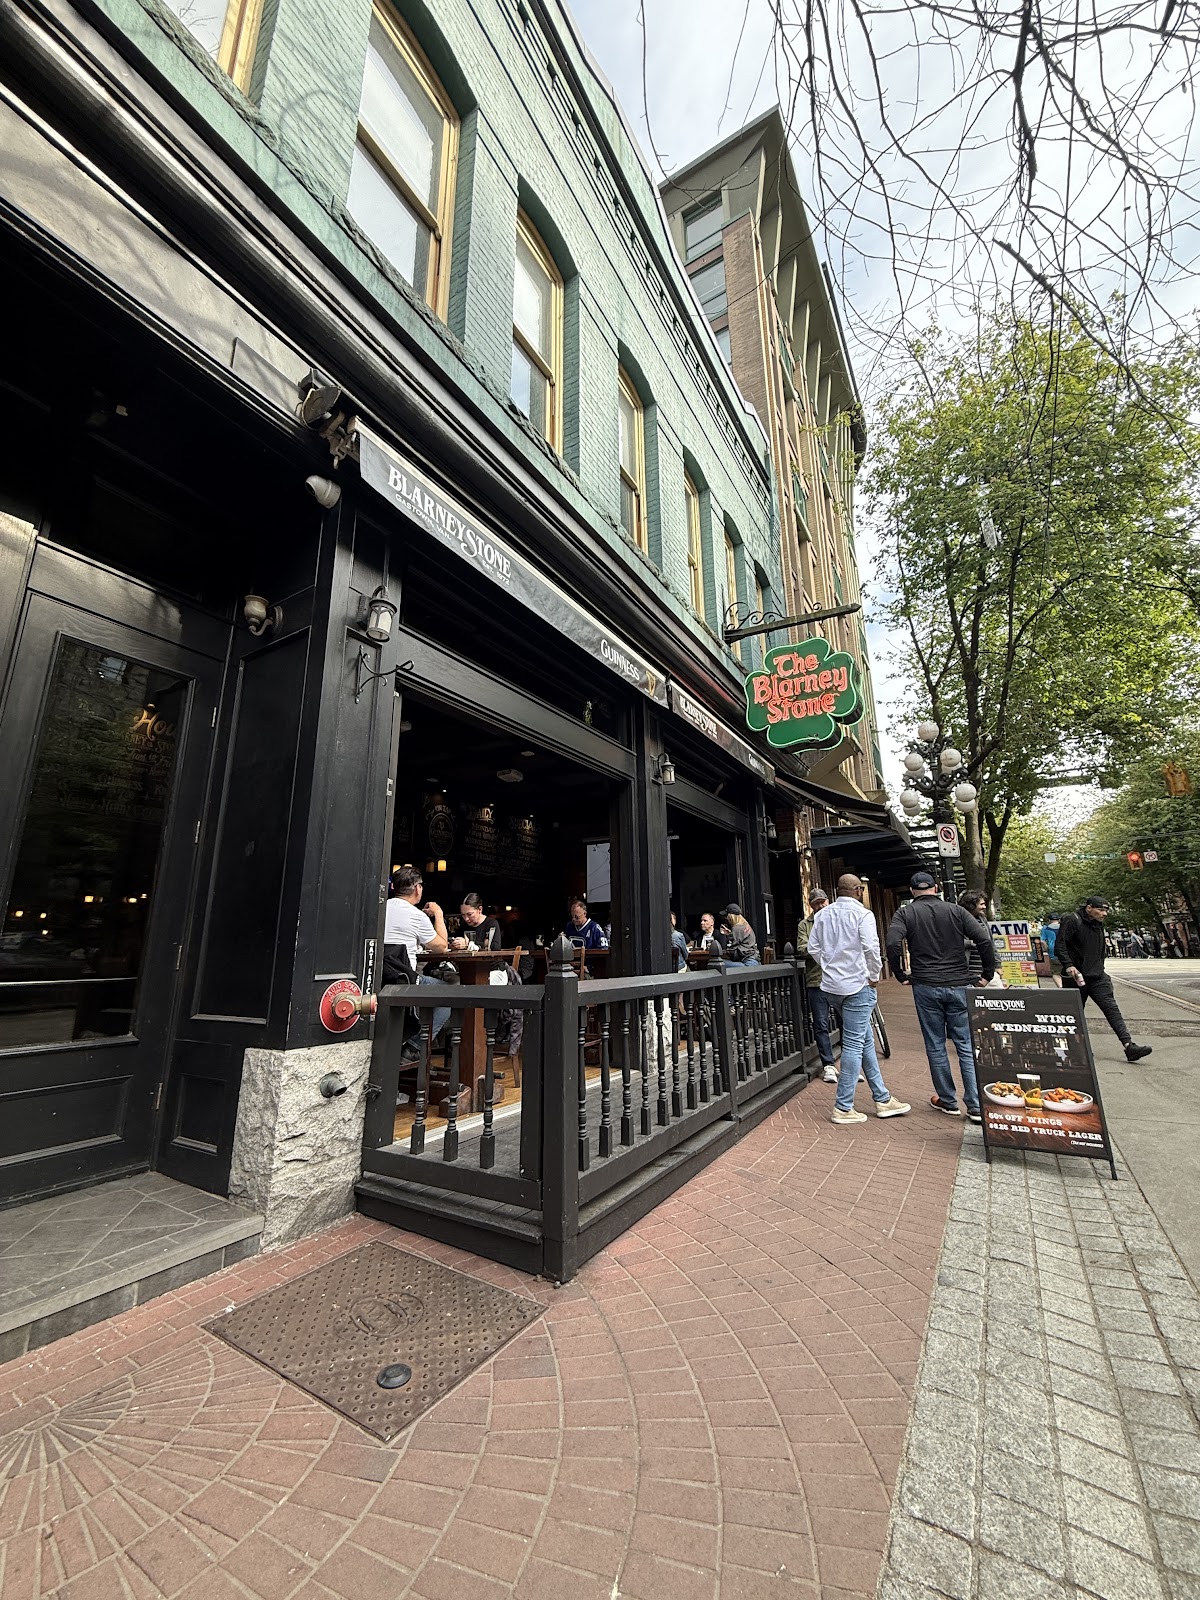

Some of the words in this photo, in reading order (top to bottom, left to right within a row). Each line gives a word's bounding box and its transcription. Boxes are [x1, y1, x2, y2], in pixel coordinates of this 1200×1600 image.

[600, 639, 640, 681] GUINNESS
[773, 651, 820, 678] The
[753, 666, 848, 705] Blarney
[767, 692, 840, 724] Stone
[991, 923, 1029, 936] ATM
[366, 967, 374, 995] LATC
[991, 1022, 1077, 1035] WEDNESDAY
[1034, 1014, 1076, 1024] WING
[1005, 1114, 1023, 1122] OFF
[1026, 1115, 1063, 1126] WINGS
[1011, 1124, 1030, 1133] RED
[1032, 1127, 1066, 1137] TRUCK
[1068, 1130, 1102, 1141] LAGER
